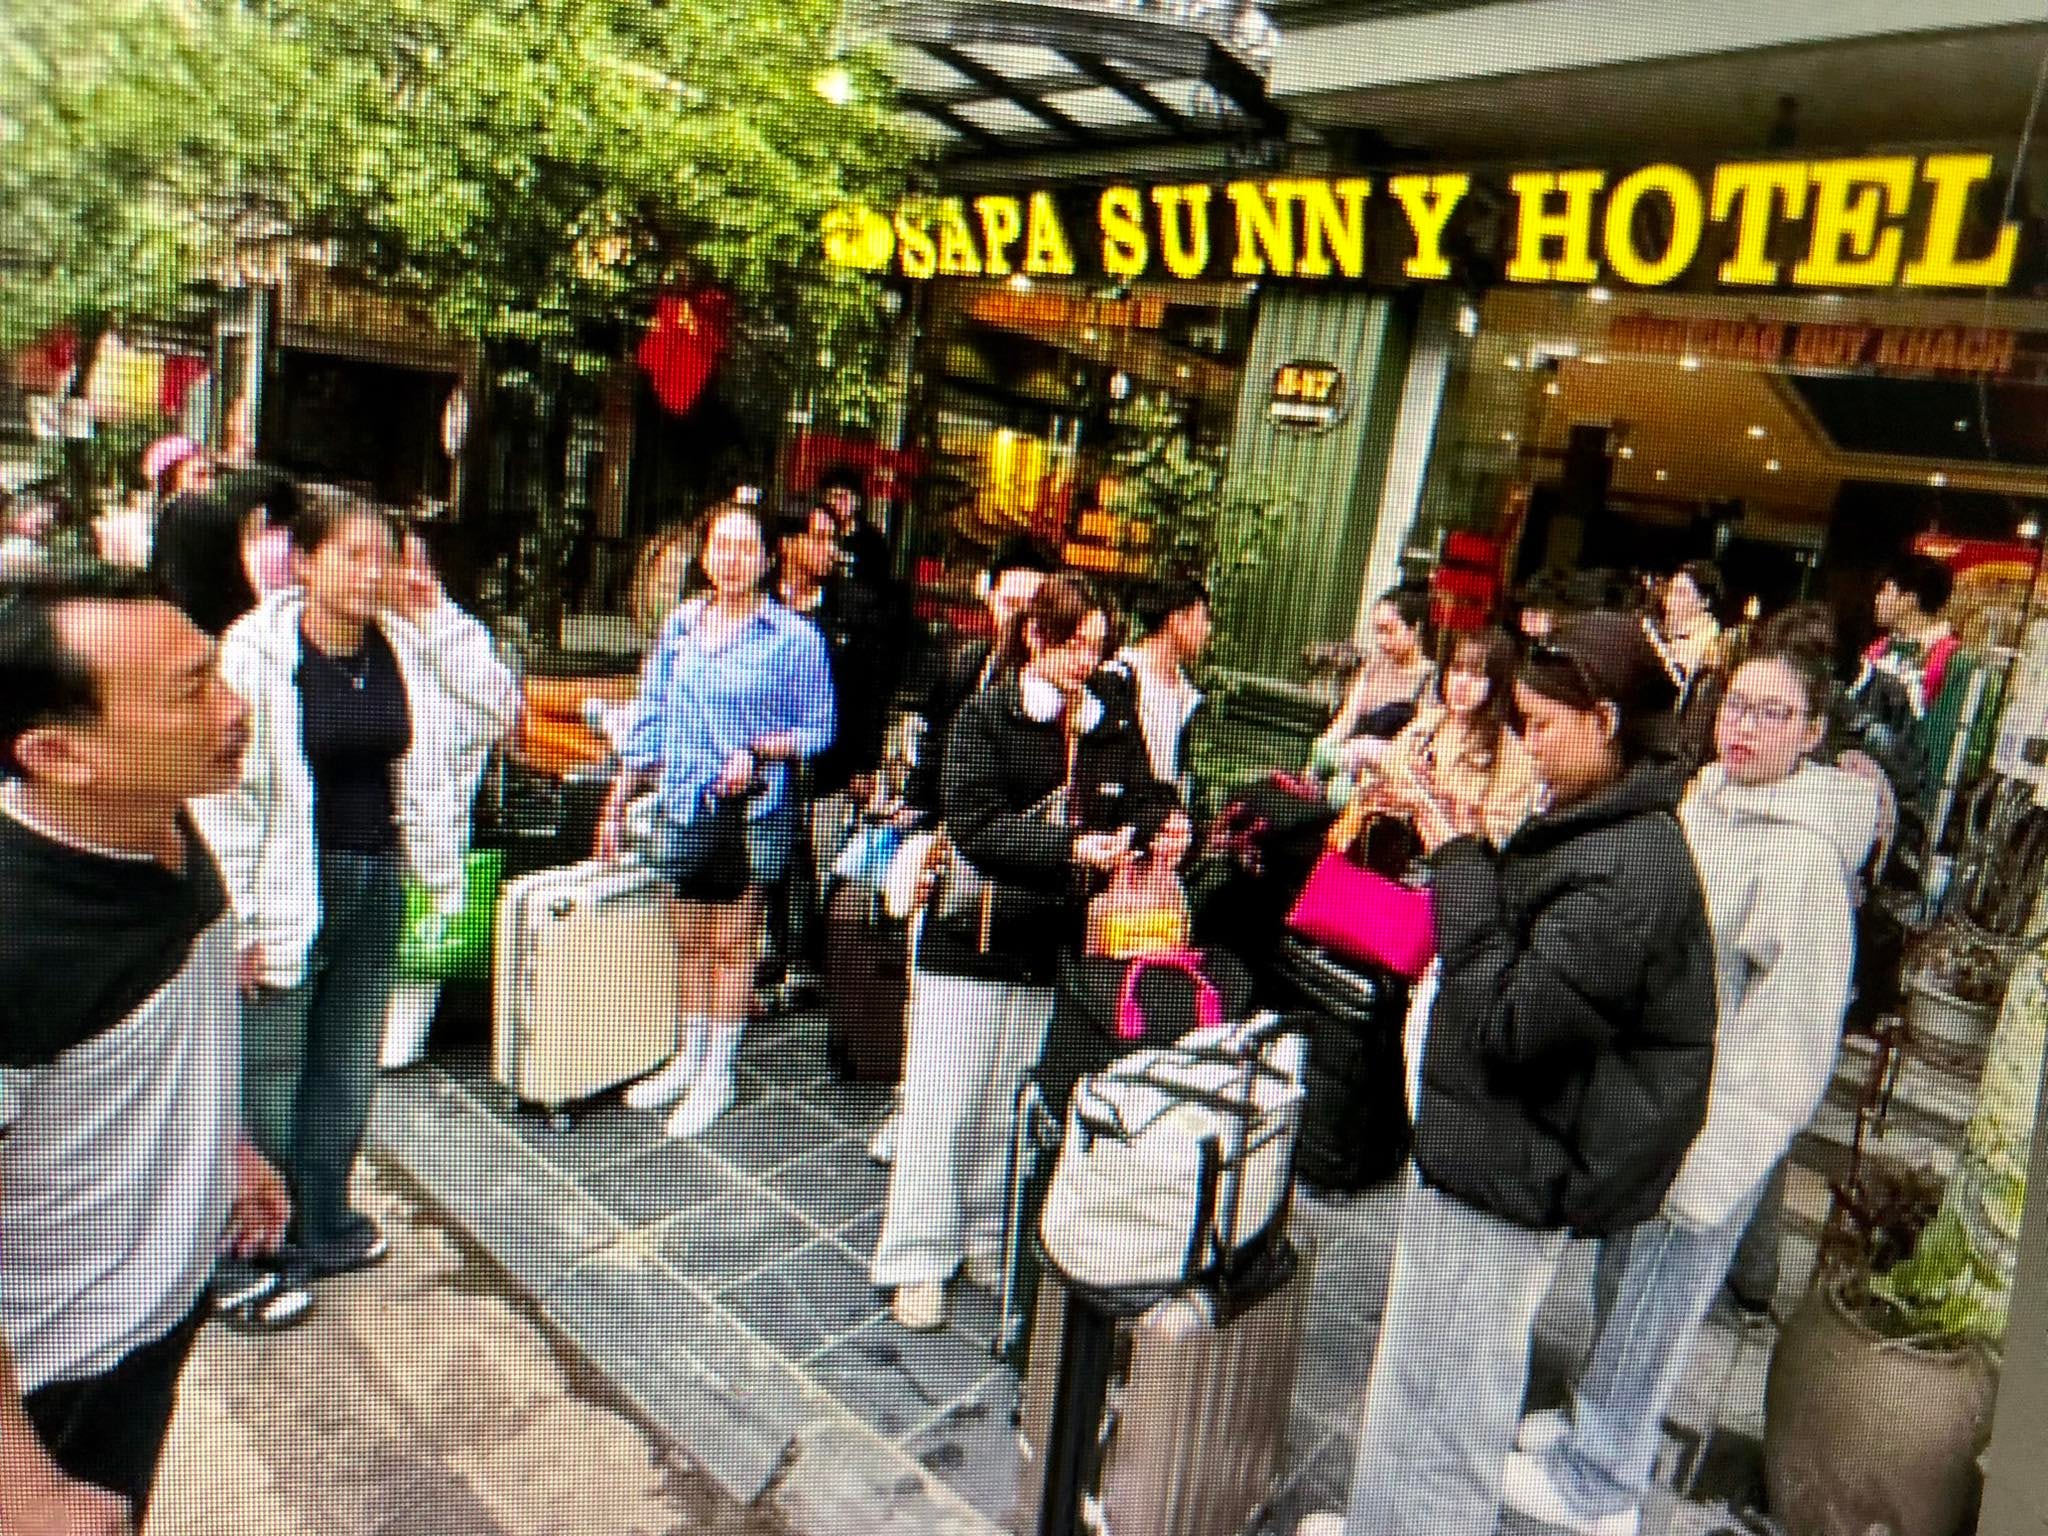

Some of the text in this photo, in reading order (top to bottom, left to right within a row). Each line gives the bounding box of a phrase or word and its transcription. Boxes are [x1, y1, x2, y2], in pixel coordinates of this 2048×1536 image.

[894, 154, 2020, 286] SAPA SUNNY HOTEL
